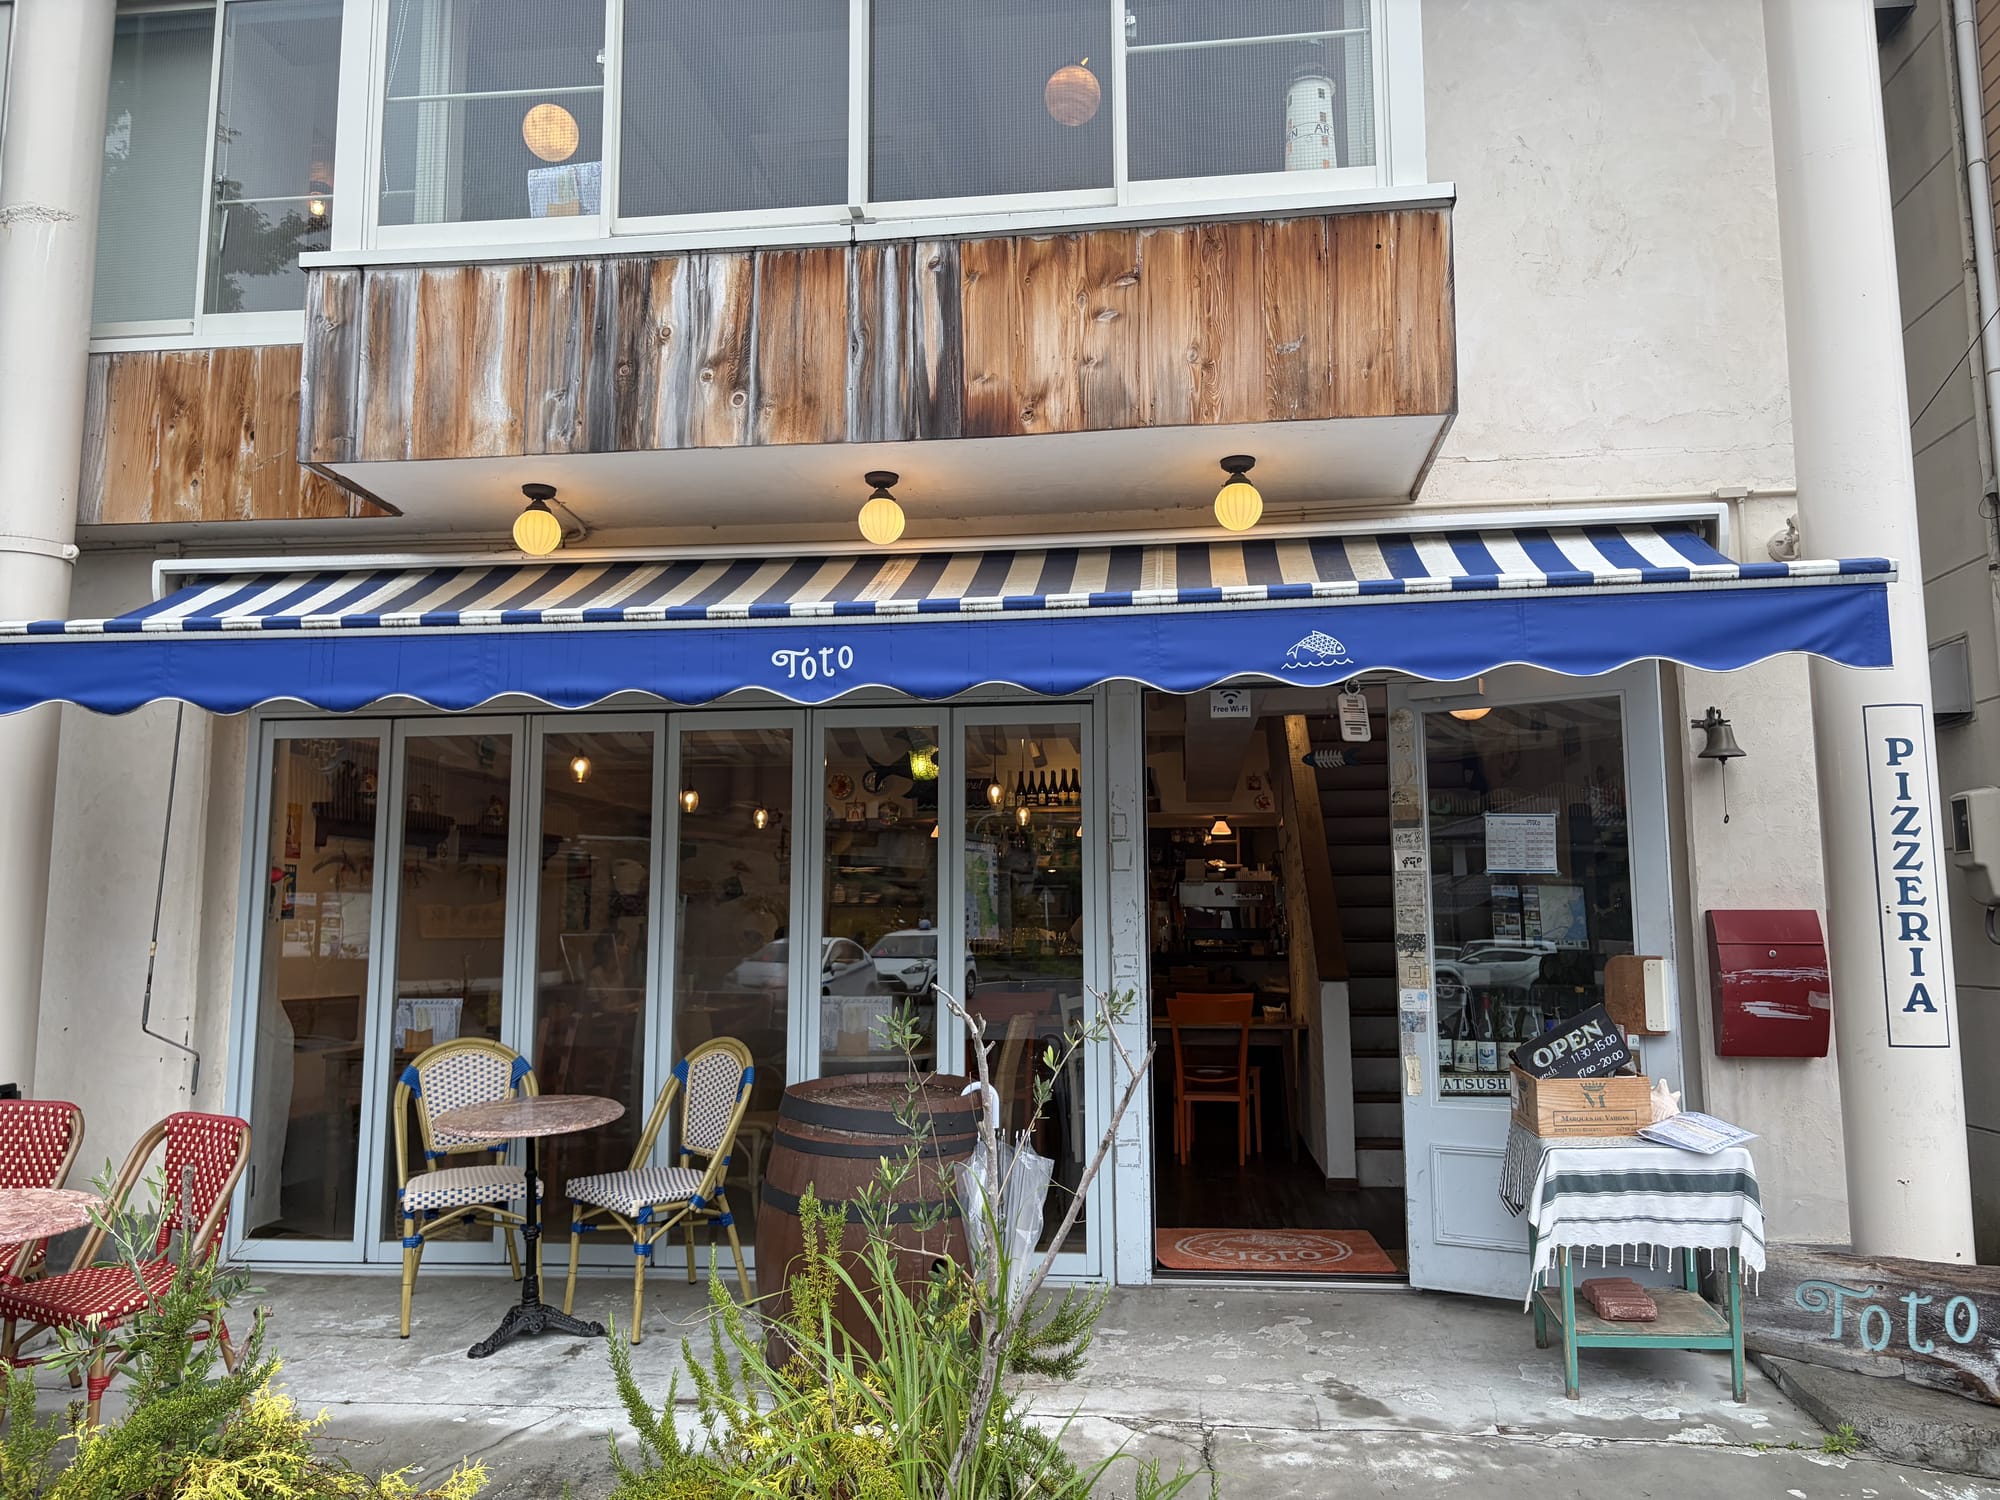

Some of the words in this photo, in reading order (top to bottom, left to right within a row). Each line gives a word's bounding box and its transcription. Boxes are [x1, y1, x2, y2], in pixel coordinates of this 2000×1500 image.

[771, 645, 854, 681] Toto
[1213, 705, 1229, 713] Free
[1230, 705, 1249, 713] Wi-Fi
[1884, 737, 1938, 1013] PIZZERIA
[1532, 1019, 1604, 1068] OPEN
[1795, 1279, 1980, 1355] Toto
